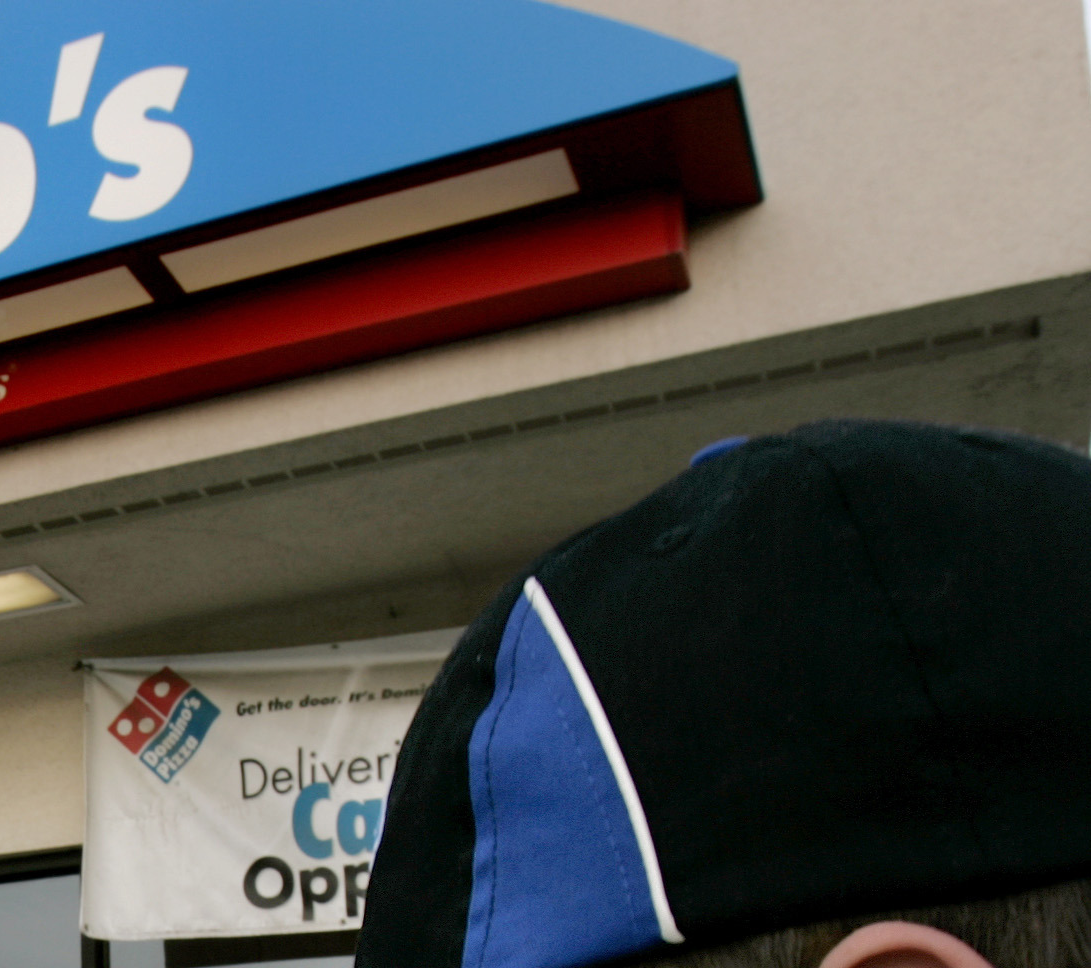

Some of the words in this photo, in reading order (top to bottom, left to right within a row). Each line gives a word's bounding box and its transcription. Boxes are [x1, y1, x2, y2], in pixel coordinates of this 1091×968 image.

[143, 697, 201, 768] Domino's
[237, 701, 262, 716] Get
[268, 698, 293, 712] the
[299, 695, 342, 708] door.
[349, 692, 376, 703] It's
[156, 735, 199, 780] Pizza
[293, 781, 383, 860] Ca
